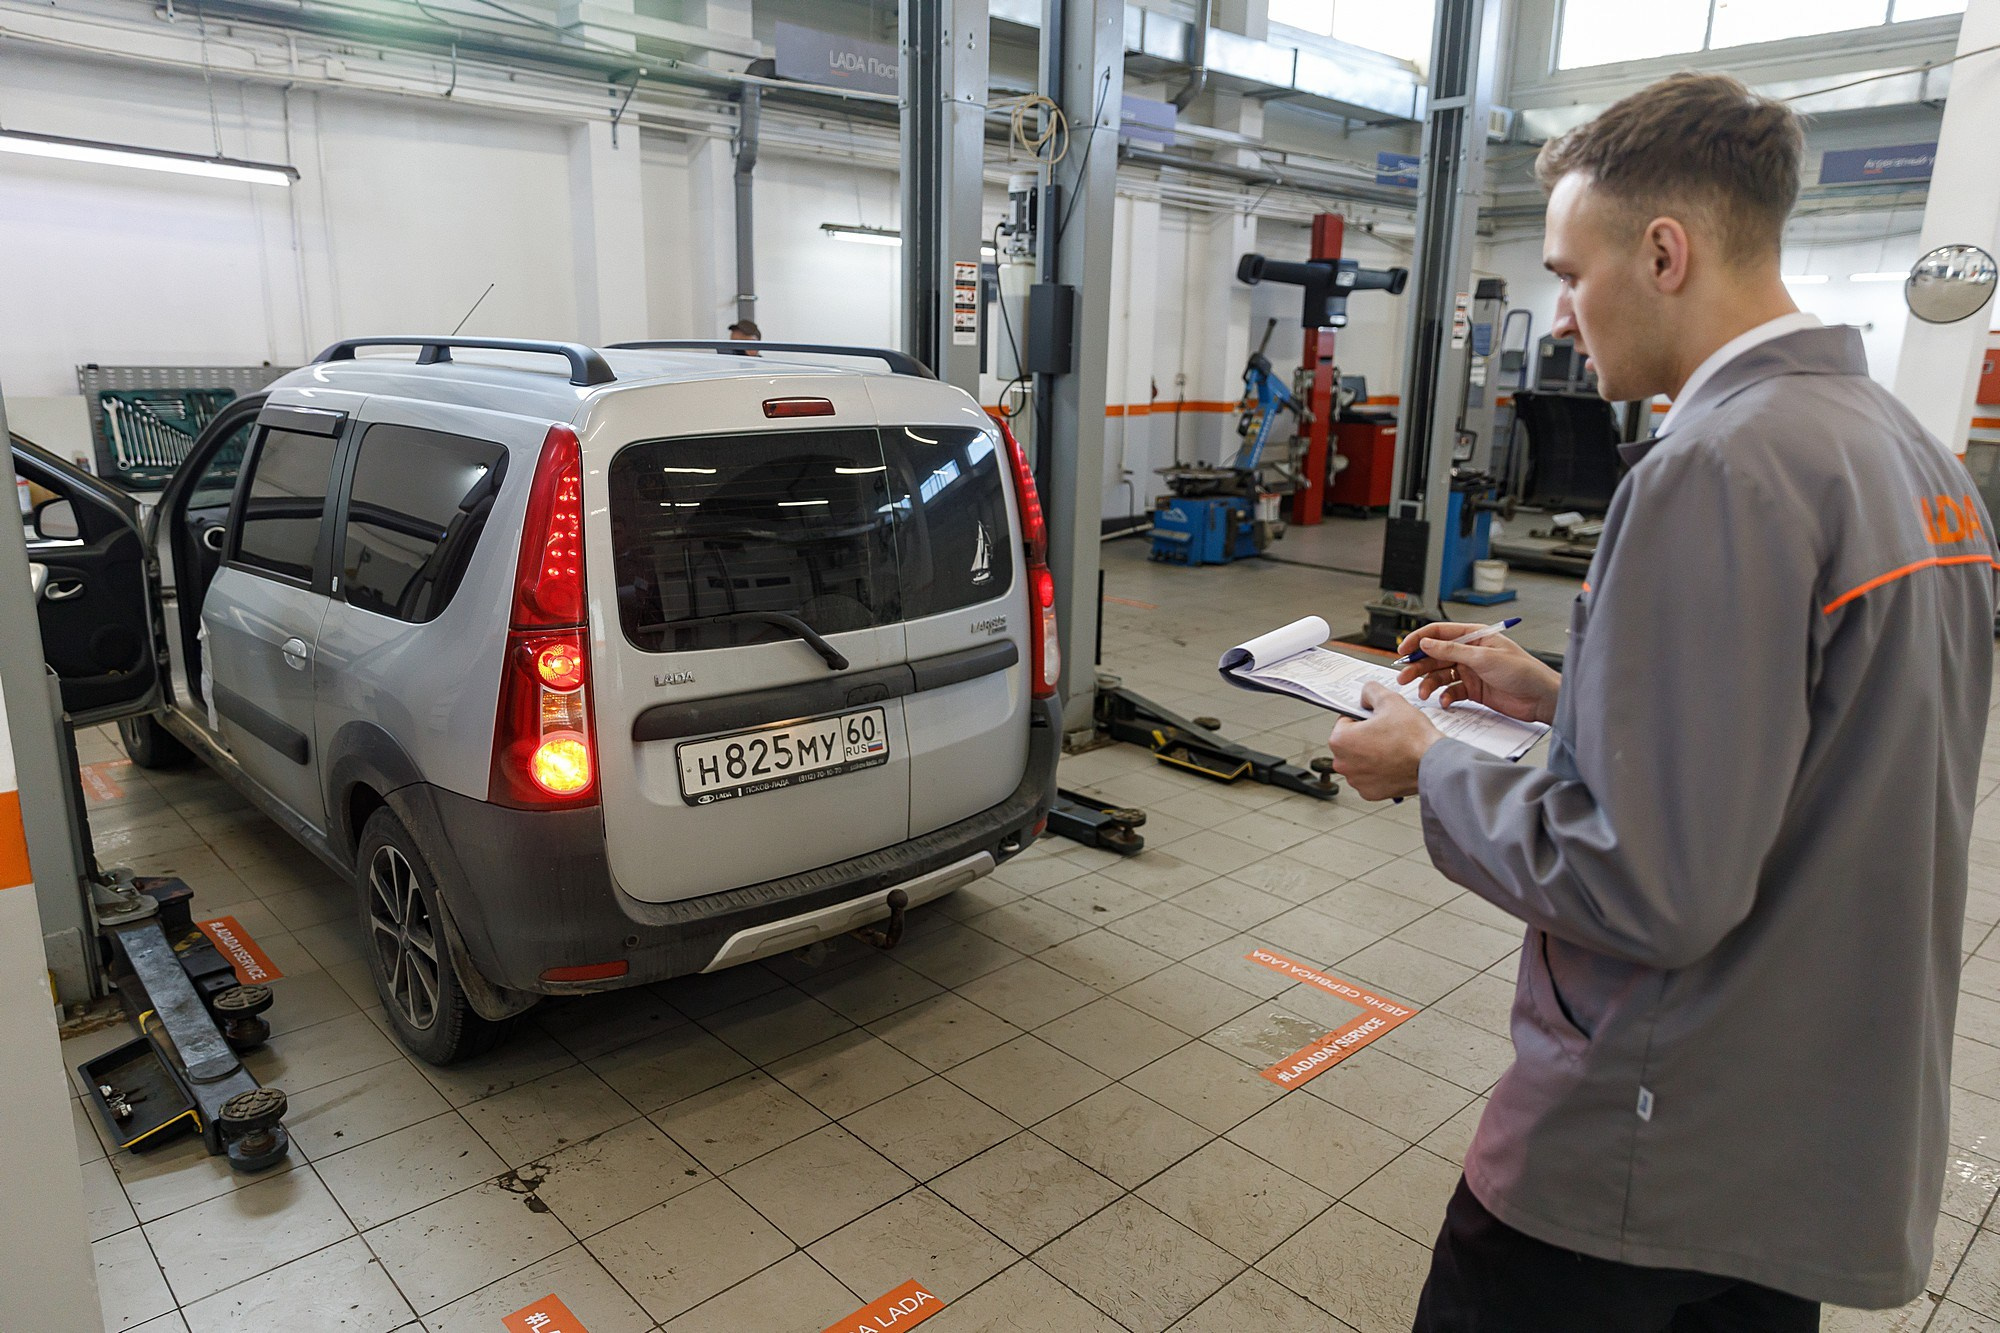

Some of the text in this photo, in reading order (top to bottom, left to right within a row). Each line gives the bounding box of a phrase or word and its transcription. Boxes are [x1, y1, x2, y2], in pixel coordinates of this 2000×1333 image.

[829, 50, 867, 73] LADA
[653, 670, 696, 687] LADA
[847, 715, 875, 744] 60
[846, 744, 868, 757] RUS
[208, 921, 268, 981] #LADADAYSERVICE
[1252, 950, 1409, 1017] ДЕНЬ СЕРВИСА LADA
[1276, 1017, 1386, 1083] #LADADAYSERVICE
[874, 1290, 935, 1328] LADA
